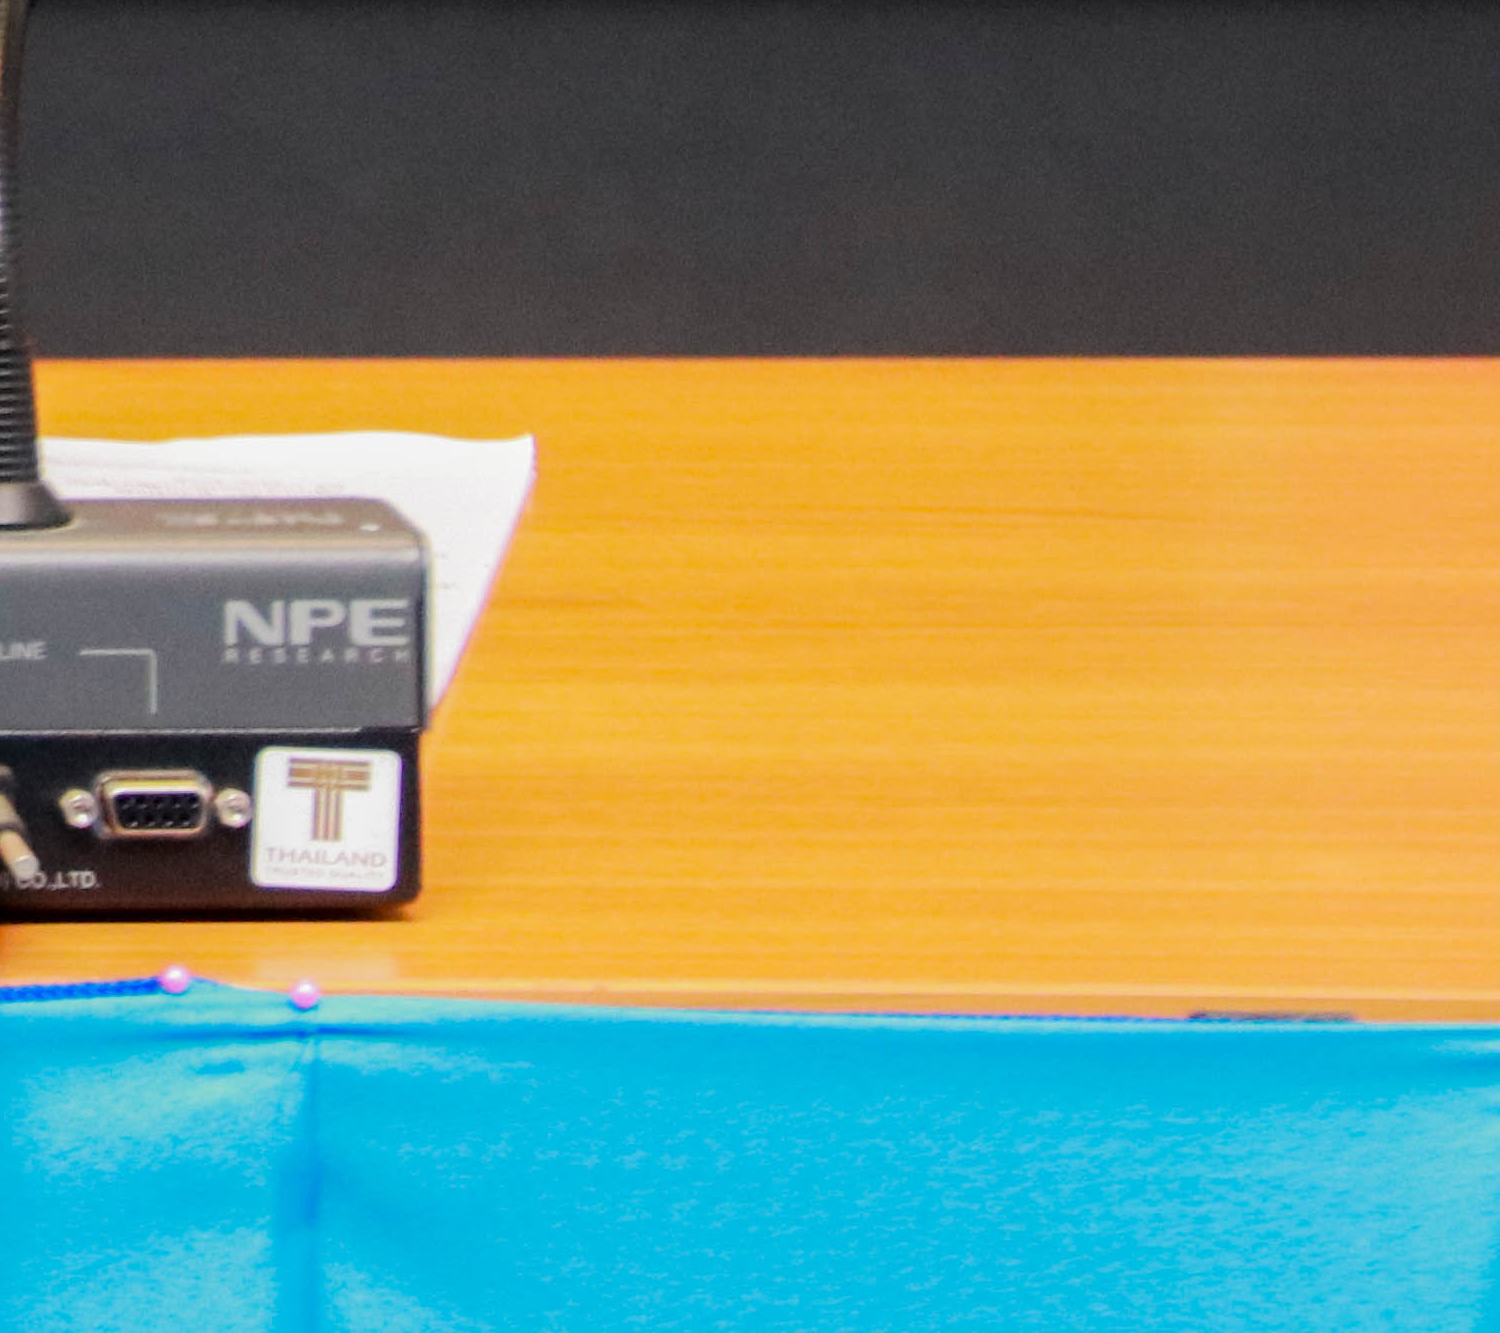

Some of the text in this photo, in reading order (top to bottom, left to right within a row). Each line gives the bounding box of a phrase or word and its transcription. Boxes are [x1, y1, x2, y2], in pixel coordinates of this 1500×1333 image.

[224, 599, 410, 646] NPE
[222, 647, 411, 664] RESEARCH
[266, 847, 388, 867] THAILAND
